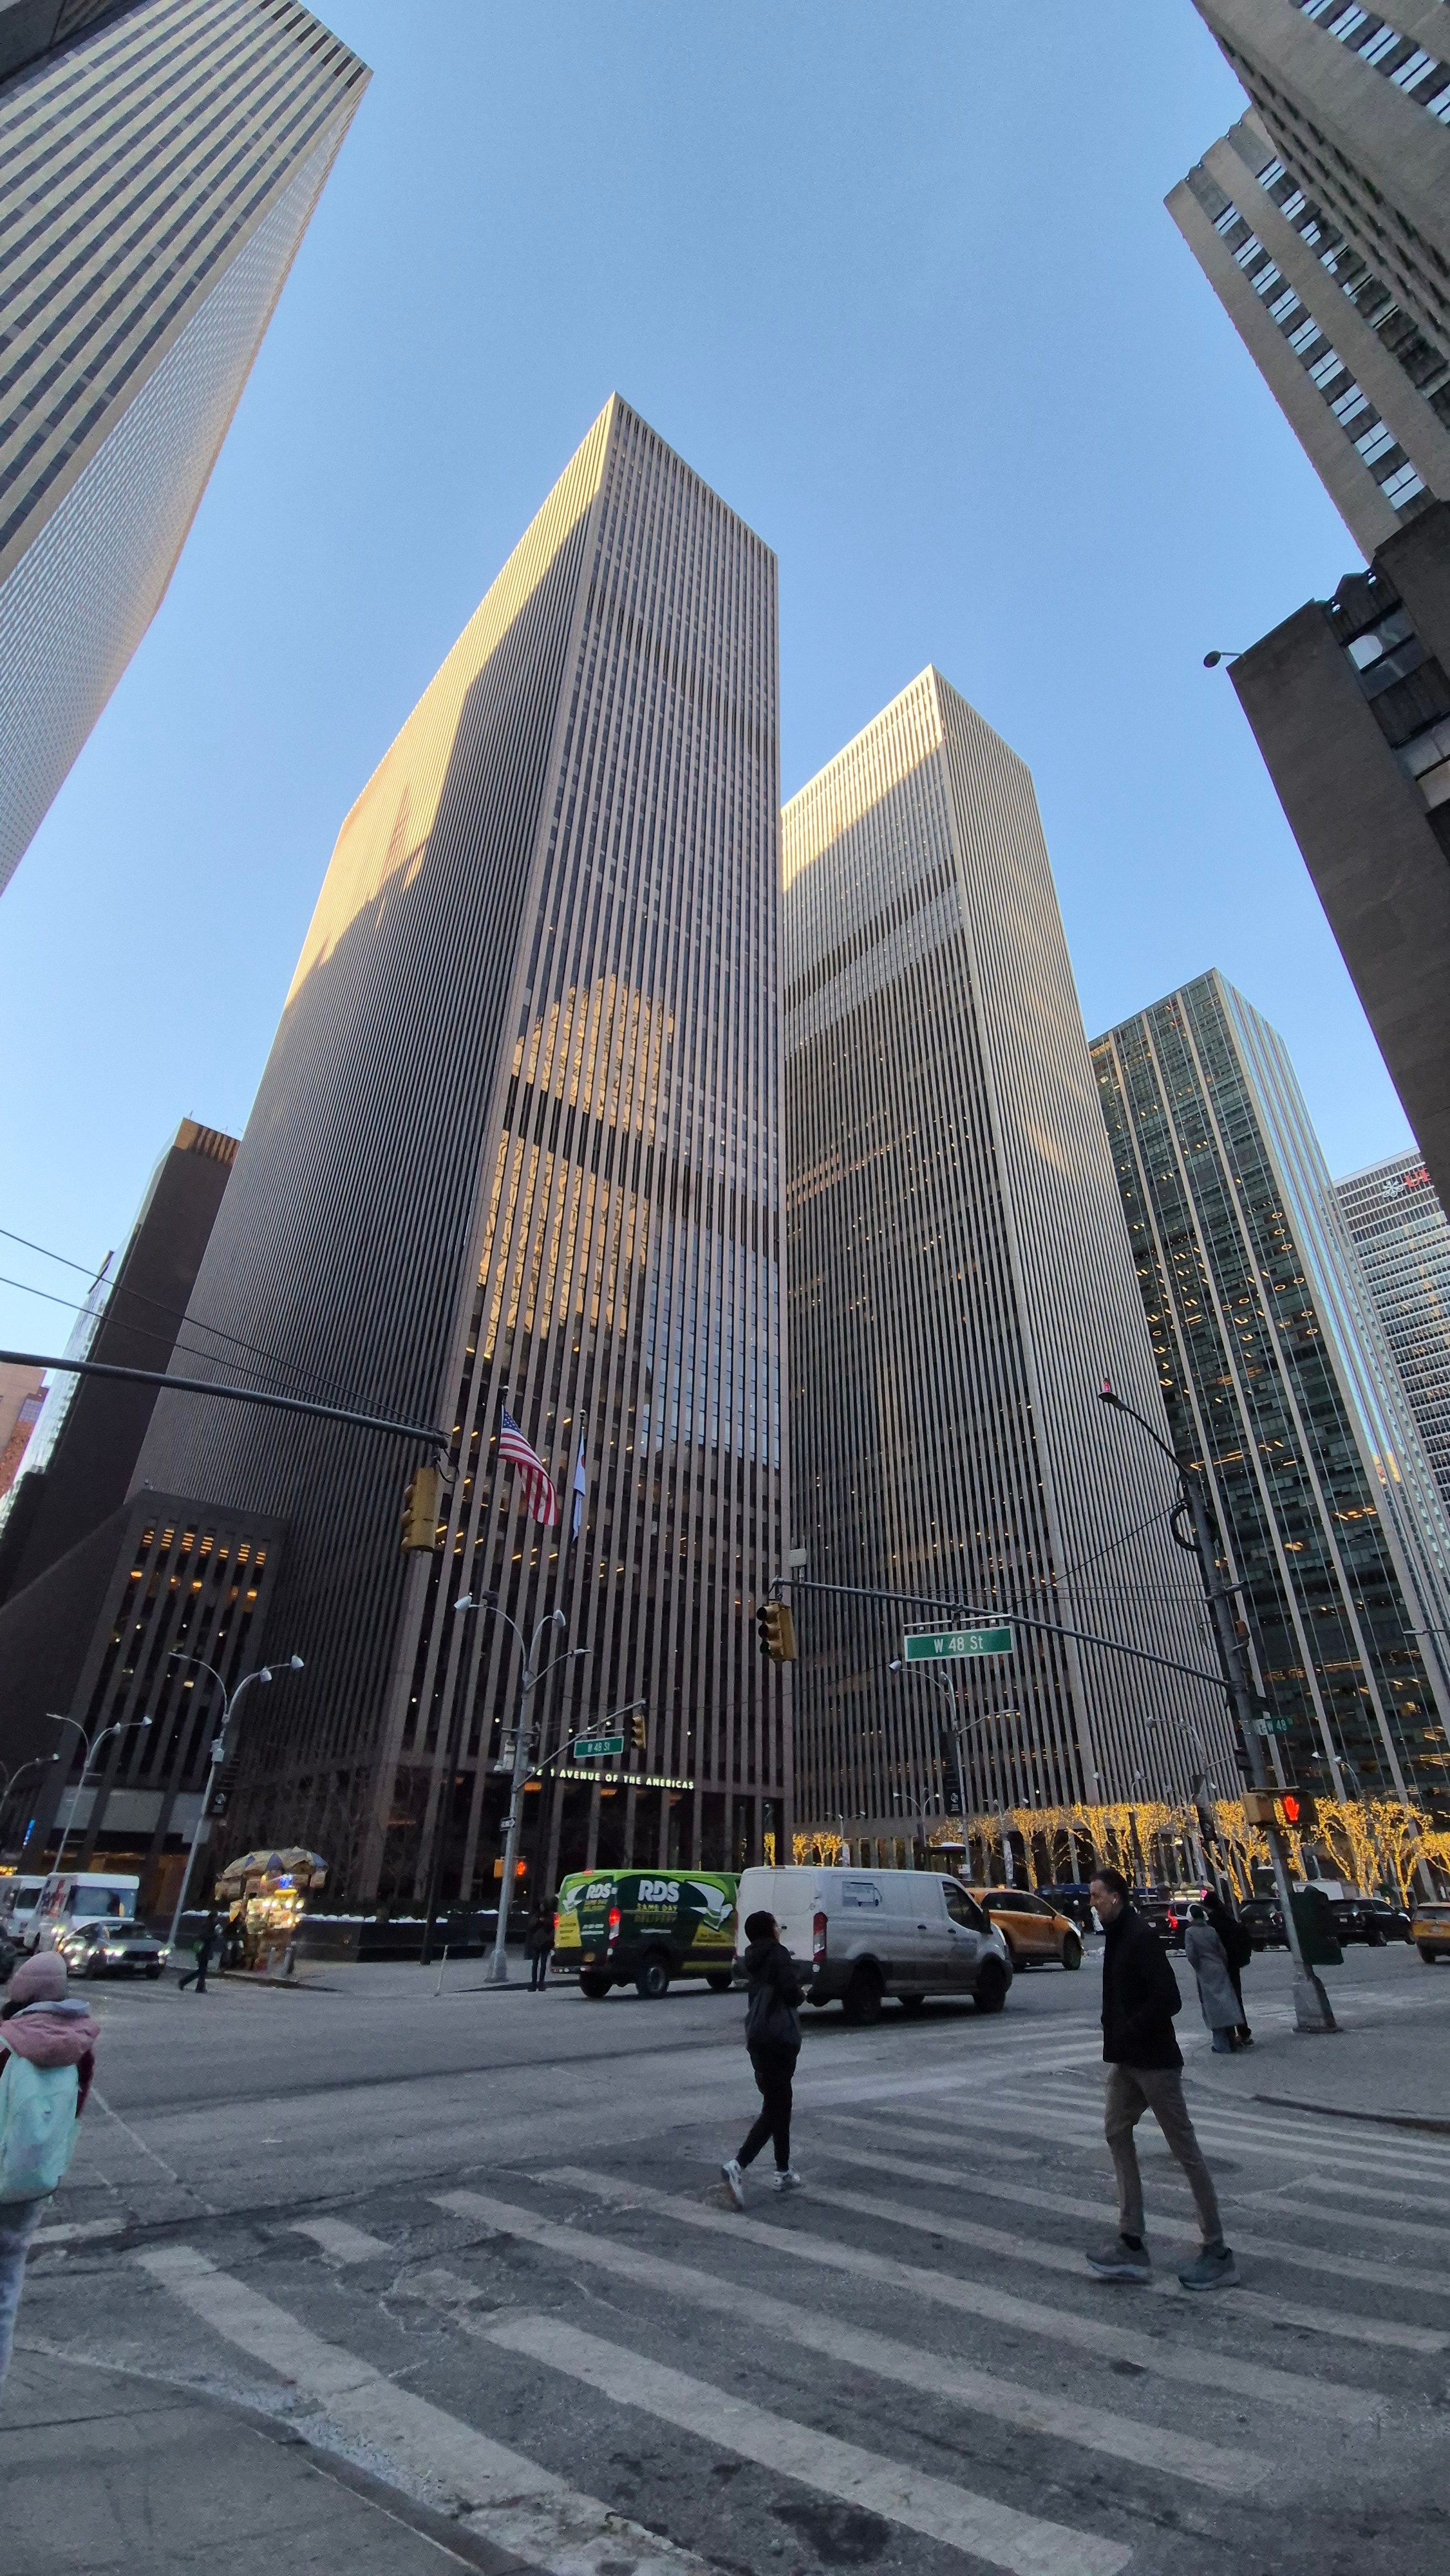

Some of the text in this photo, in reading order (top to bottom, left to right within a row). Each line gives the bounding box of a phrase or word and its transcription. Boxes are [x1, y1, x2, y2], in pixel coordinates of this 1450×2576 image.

[934, 1635, 984, 1654] W 48 St
[1266, 1720, 1274, 1732] W
[1276, 1719, 1287, 1731] 48
[559, 1768, 600, 1782] AVENUE
[605, 1773, 618, 1783] OF
[623, 1775, 641, 1785] THE
[645, 1777, 694, 1790] AMERICAS
[585, 1882, 612, 1900] RDS
[637, 1879, 680, 1902] RDS
[662, 1904, 678, 1912] DAY
